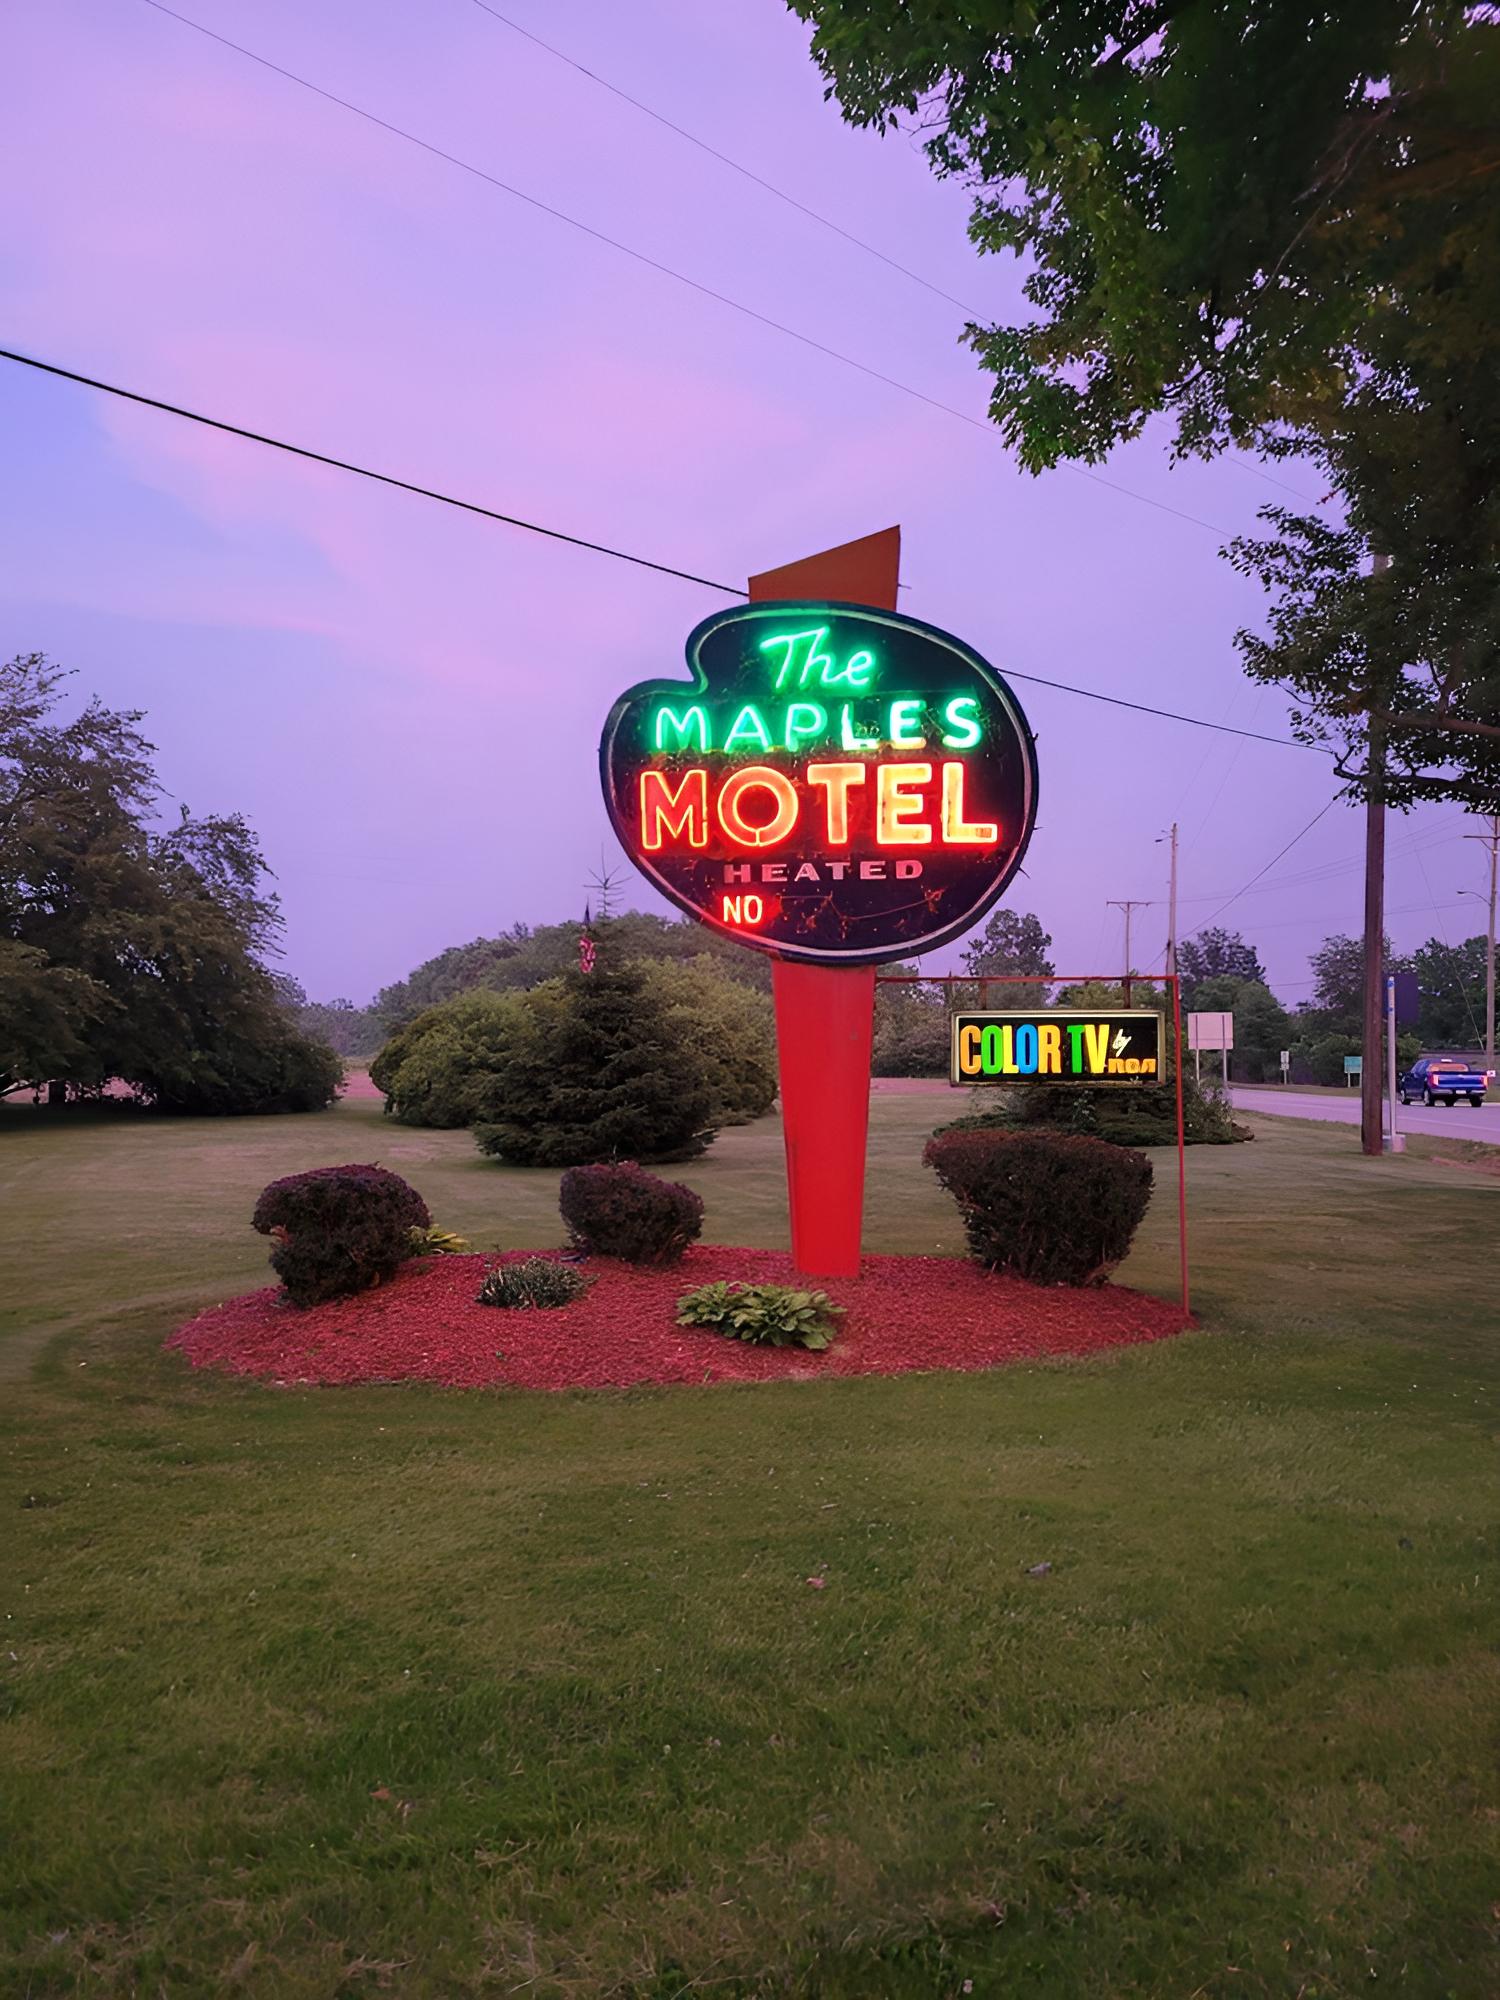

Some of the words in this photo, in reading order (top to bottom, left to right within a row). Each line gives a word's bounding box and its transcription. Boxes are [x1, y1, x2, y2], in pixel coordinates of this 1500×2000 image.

[759, 625, 873, 689] The
[655, 697, 982, 753] MAPLES
[640, 761, 998, 850] MOTEL
[723, 860, 924, 884] HEATED
[722, 895, 764, 924] NO
[960, 1024, 1062, 1075] COLOR
[1066, 1024, 1110, 1074] TV
